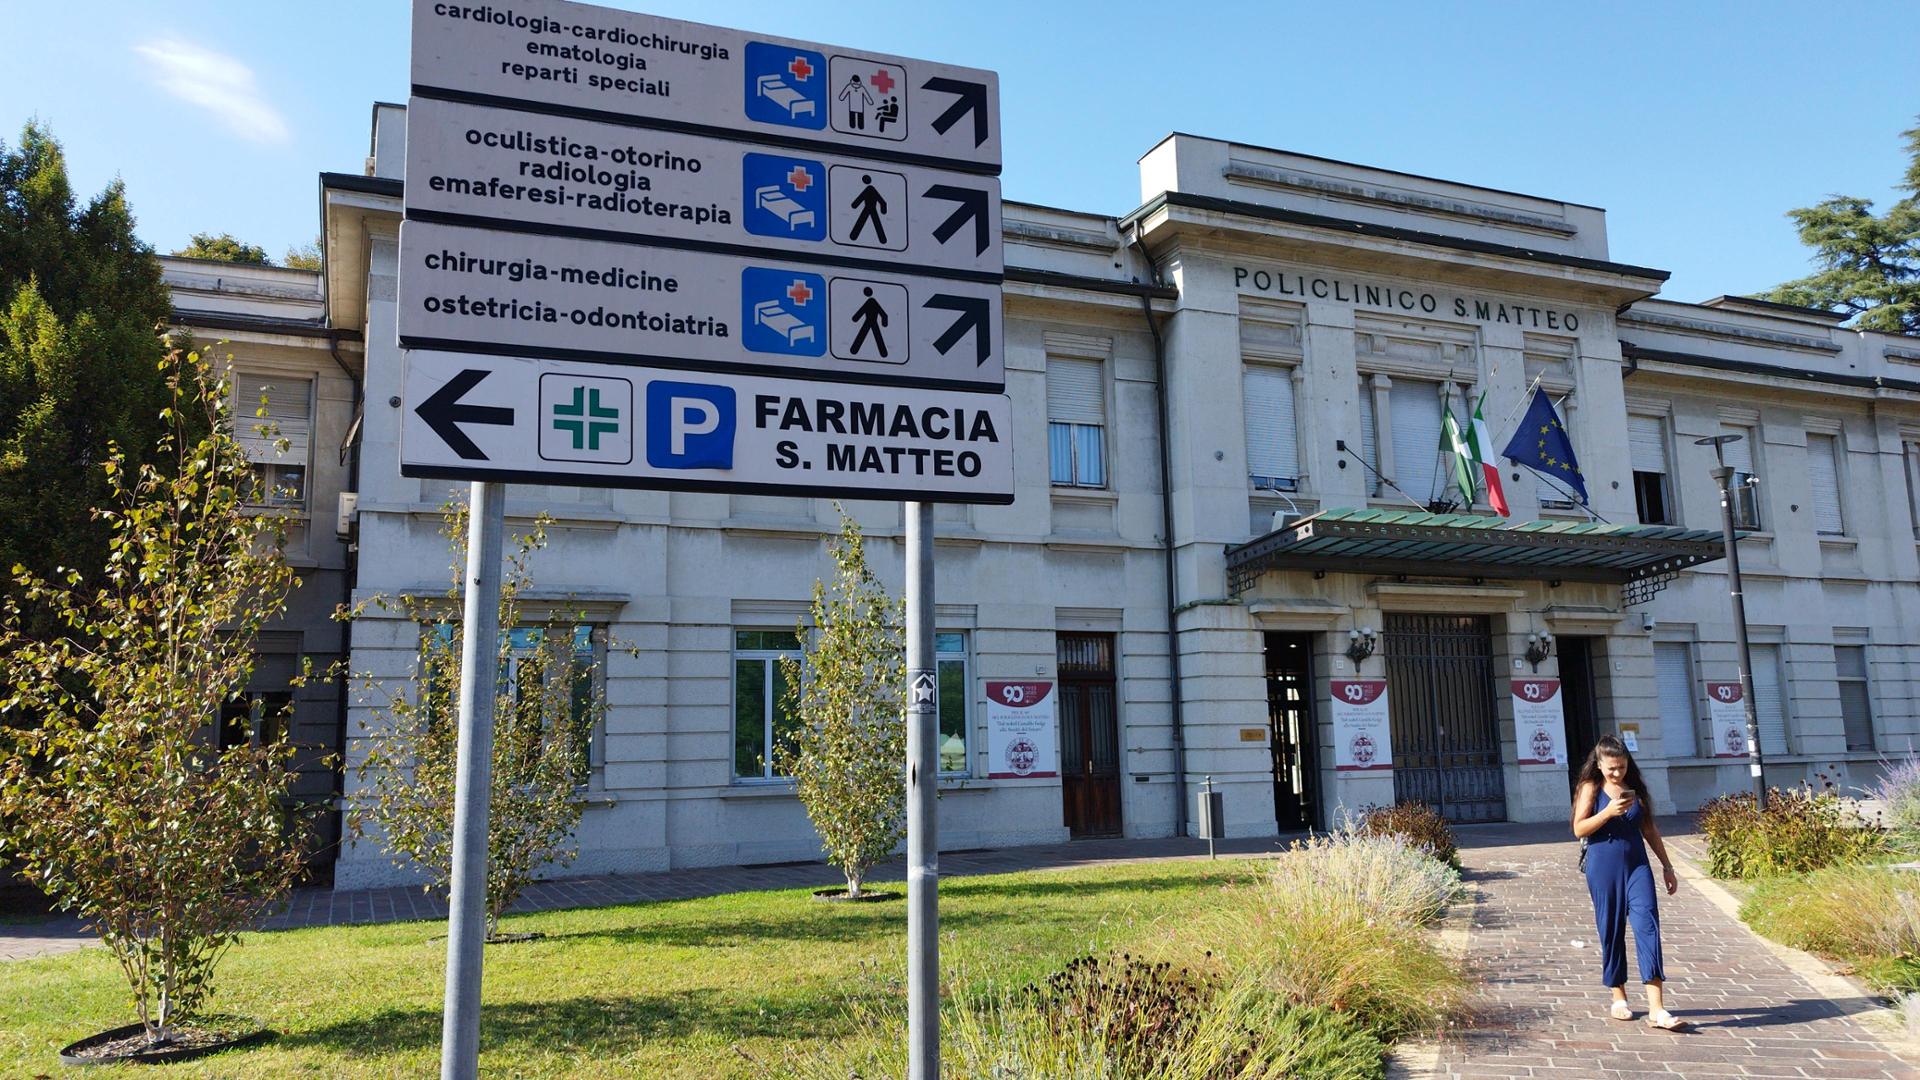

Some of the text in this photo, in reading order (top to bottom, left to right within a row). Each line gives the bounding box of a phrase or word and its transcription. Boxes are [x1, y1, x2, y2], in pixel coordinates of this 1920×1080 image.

[434, 3, 730, 61] cardiologia-cardiochirurgia
[526, 41, 647, 72] ematologia
[501, 61, 670, 98] reparti speciali
[466, 129, 702, 175] oculistica-otorino
[519, 160, 652, 193] radiologia
[428, 175, 733, 226] emaferesi-radioterapia
[424, 249, 679, 293] chirurgia-medicine
[1233, 266, 1437, 313] POLICLINICO
[423, 294, 730, 338] ostetricia-odontoiatria
[671, 396, 720, 456] P
[755, 394, 999, 443] FARMACIA
[775, 440, 982, 479] S. MATTEO
